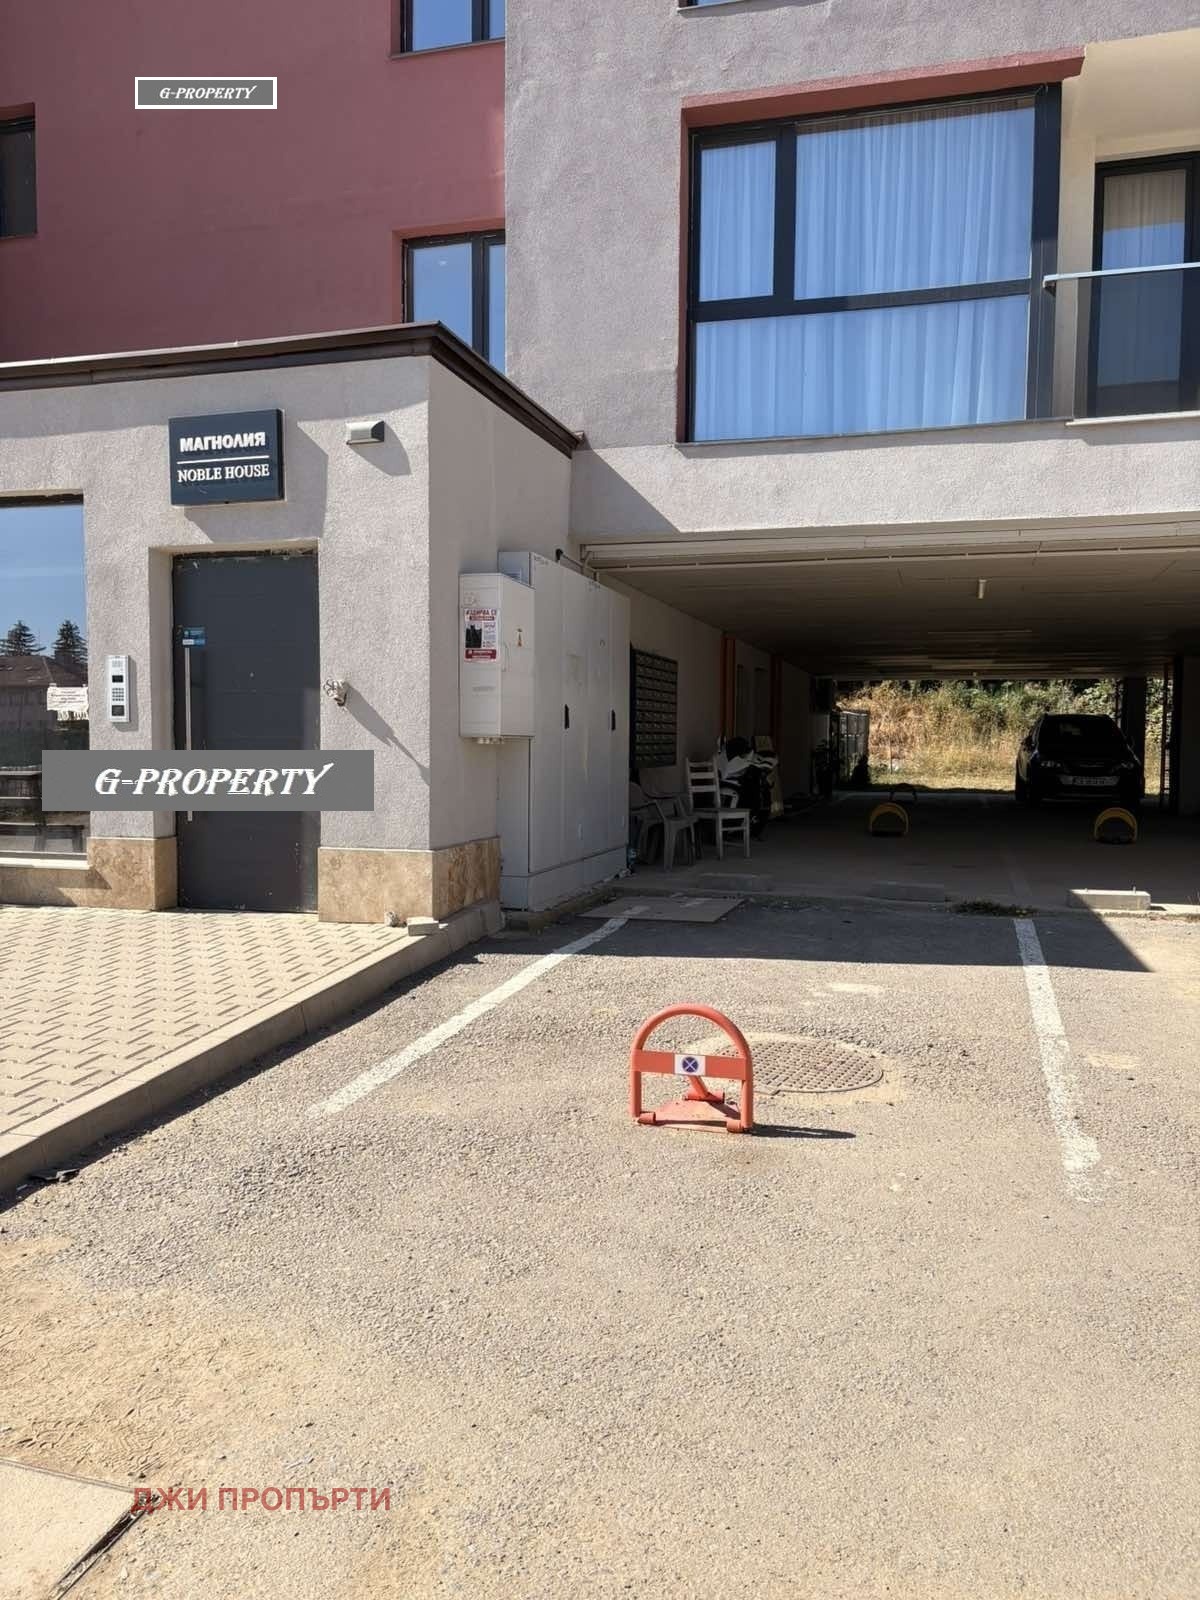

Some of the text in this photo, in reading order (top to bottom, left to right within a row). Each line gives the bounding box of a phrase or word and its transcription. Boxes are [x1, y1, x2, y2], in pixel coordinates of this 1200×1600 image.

[180, 432, 266, 452] МАГНОЛИЯ
[177, 464, 270, 482] NOBLE HOUSE
